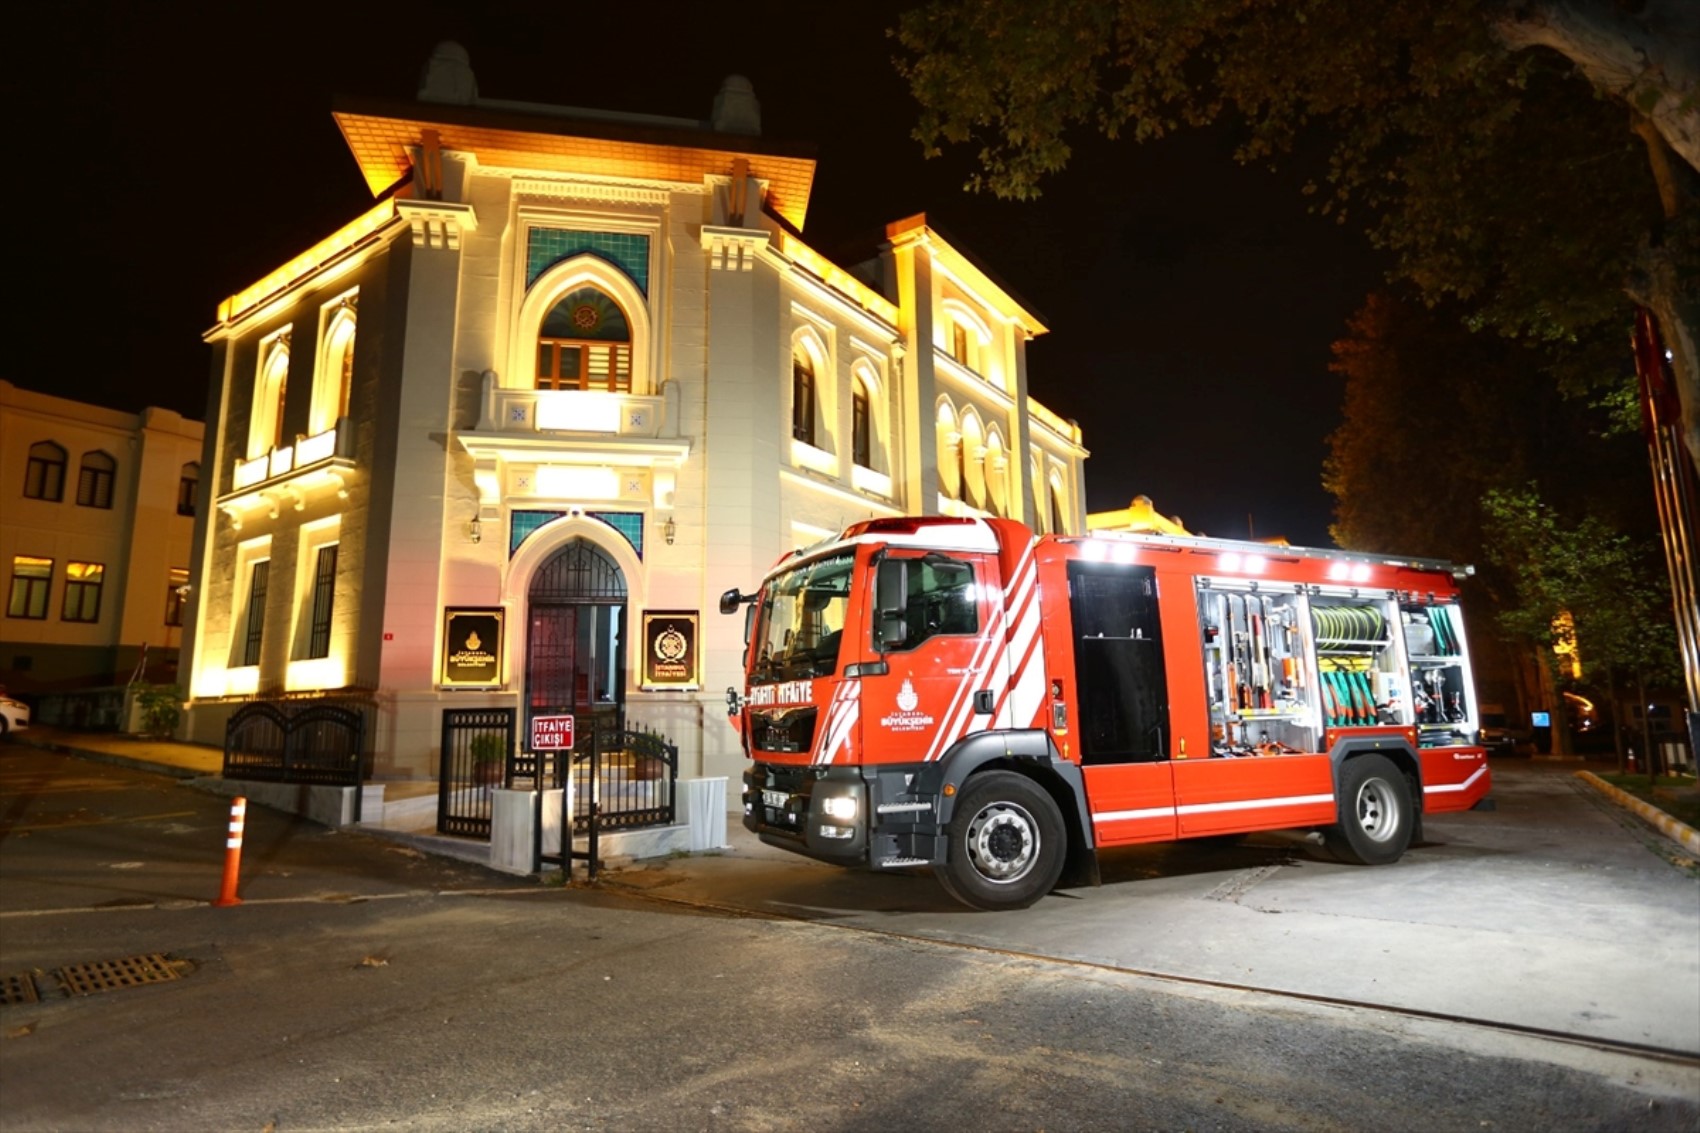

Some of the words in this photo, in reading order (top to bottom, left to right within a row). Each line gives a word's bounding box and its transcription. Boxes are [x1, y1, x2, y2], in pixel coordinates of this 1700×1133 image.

[534, 719, 571, 732] İTFAİYE
[881, 715, 933, 727] BÜYÜKŞEHİR
[535, 732, 563, 748] ÇIKIŞI
